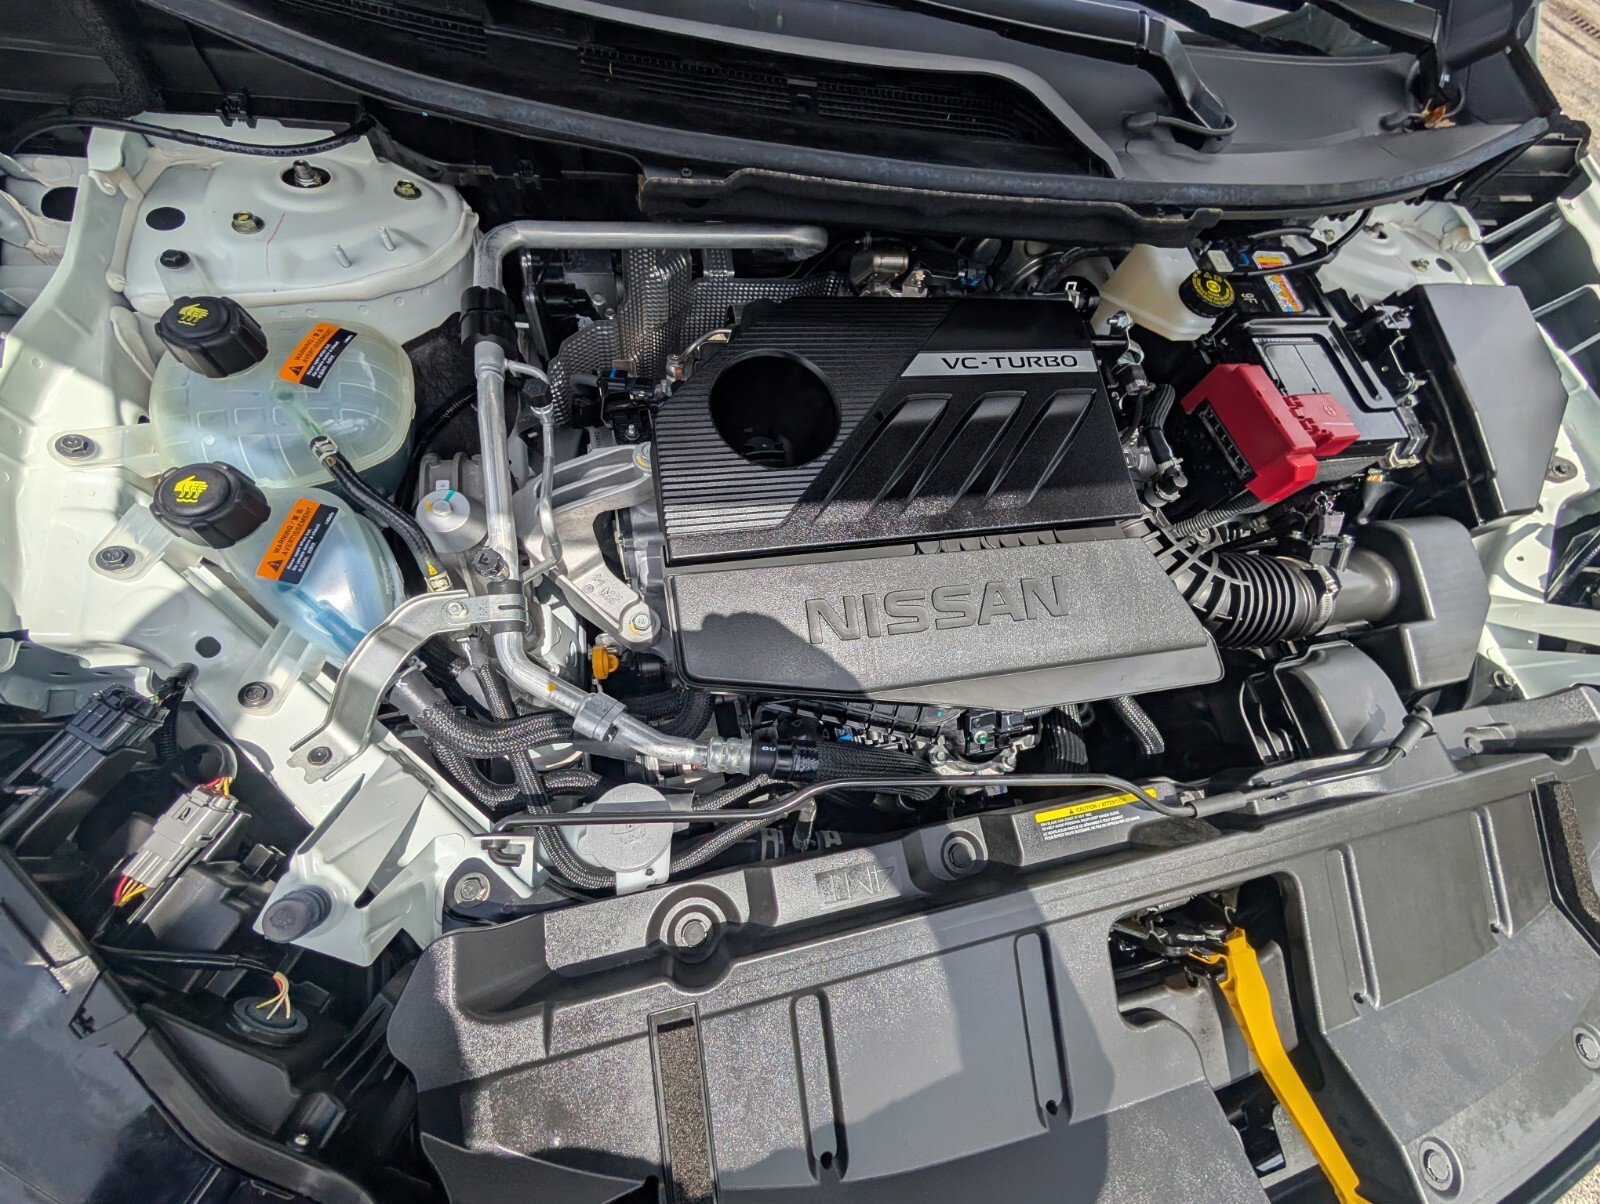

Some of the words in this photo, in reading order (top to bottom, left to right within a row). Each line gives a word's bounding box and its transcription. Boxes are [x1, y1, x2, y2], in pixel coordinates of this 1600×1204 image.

[294, 338, 314, 361] WARNING
[941, 355, 1078, 369] VC-TURBO
[273, 525, 294, 554] WARNING
[282, 507, 313, 556] AVERTISSEMENT
[805, 575, 1069, 644] NISSAN
[1076, 804, 1098, 812] CAUTION
